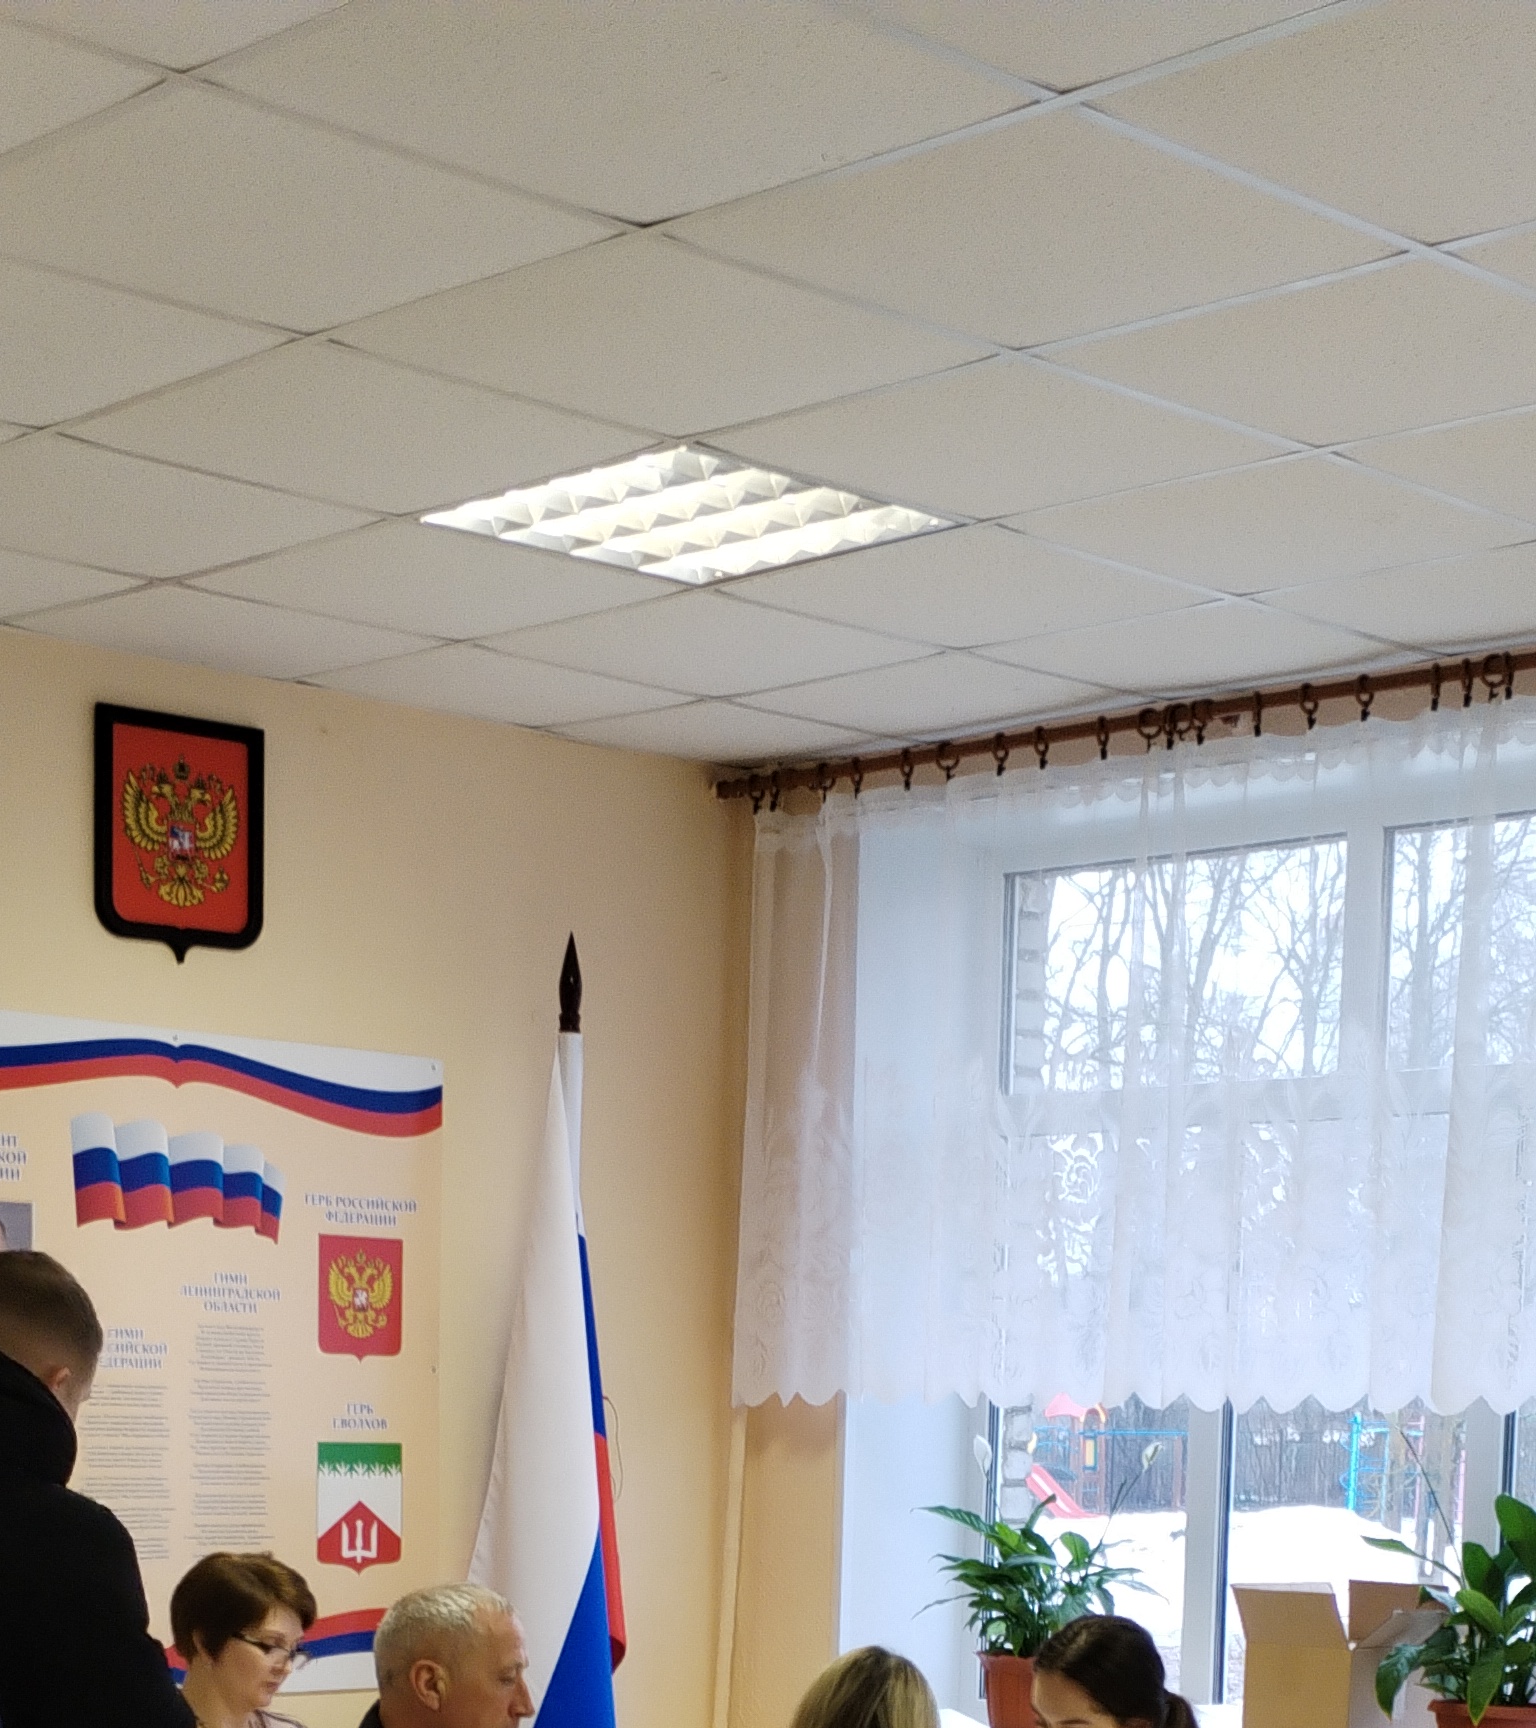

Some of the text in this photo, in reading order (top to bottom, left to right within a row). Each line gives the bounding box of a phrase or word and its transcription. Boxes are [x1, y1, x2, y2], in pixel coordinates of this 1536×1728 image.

[305, 1194, 417, 1213] ГЕРБ РОССИЙСКОЙ
[325, 1210, 397, 1226] ФЕДЕРАЦИИ
[214, 1272, 247, 1285] ГИМН
[180, 1285, 281, 1301] ЛЕНИНГРАДСКОЙ
[203, 1301, 257, 1314] ОБЛАСТИ
[106, 1341, 168, 1355] СИЙСКОЙ
[347, 1403, 374, 1414] ГЕРБ
